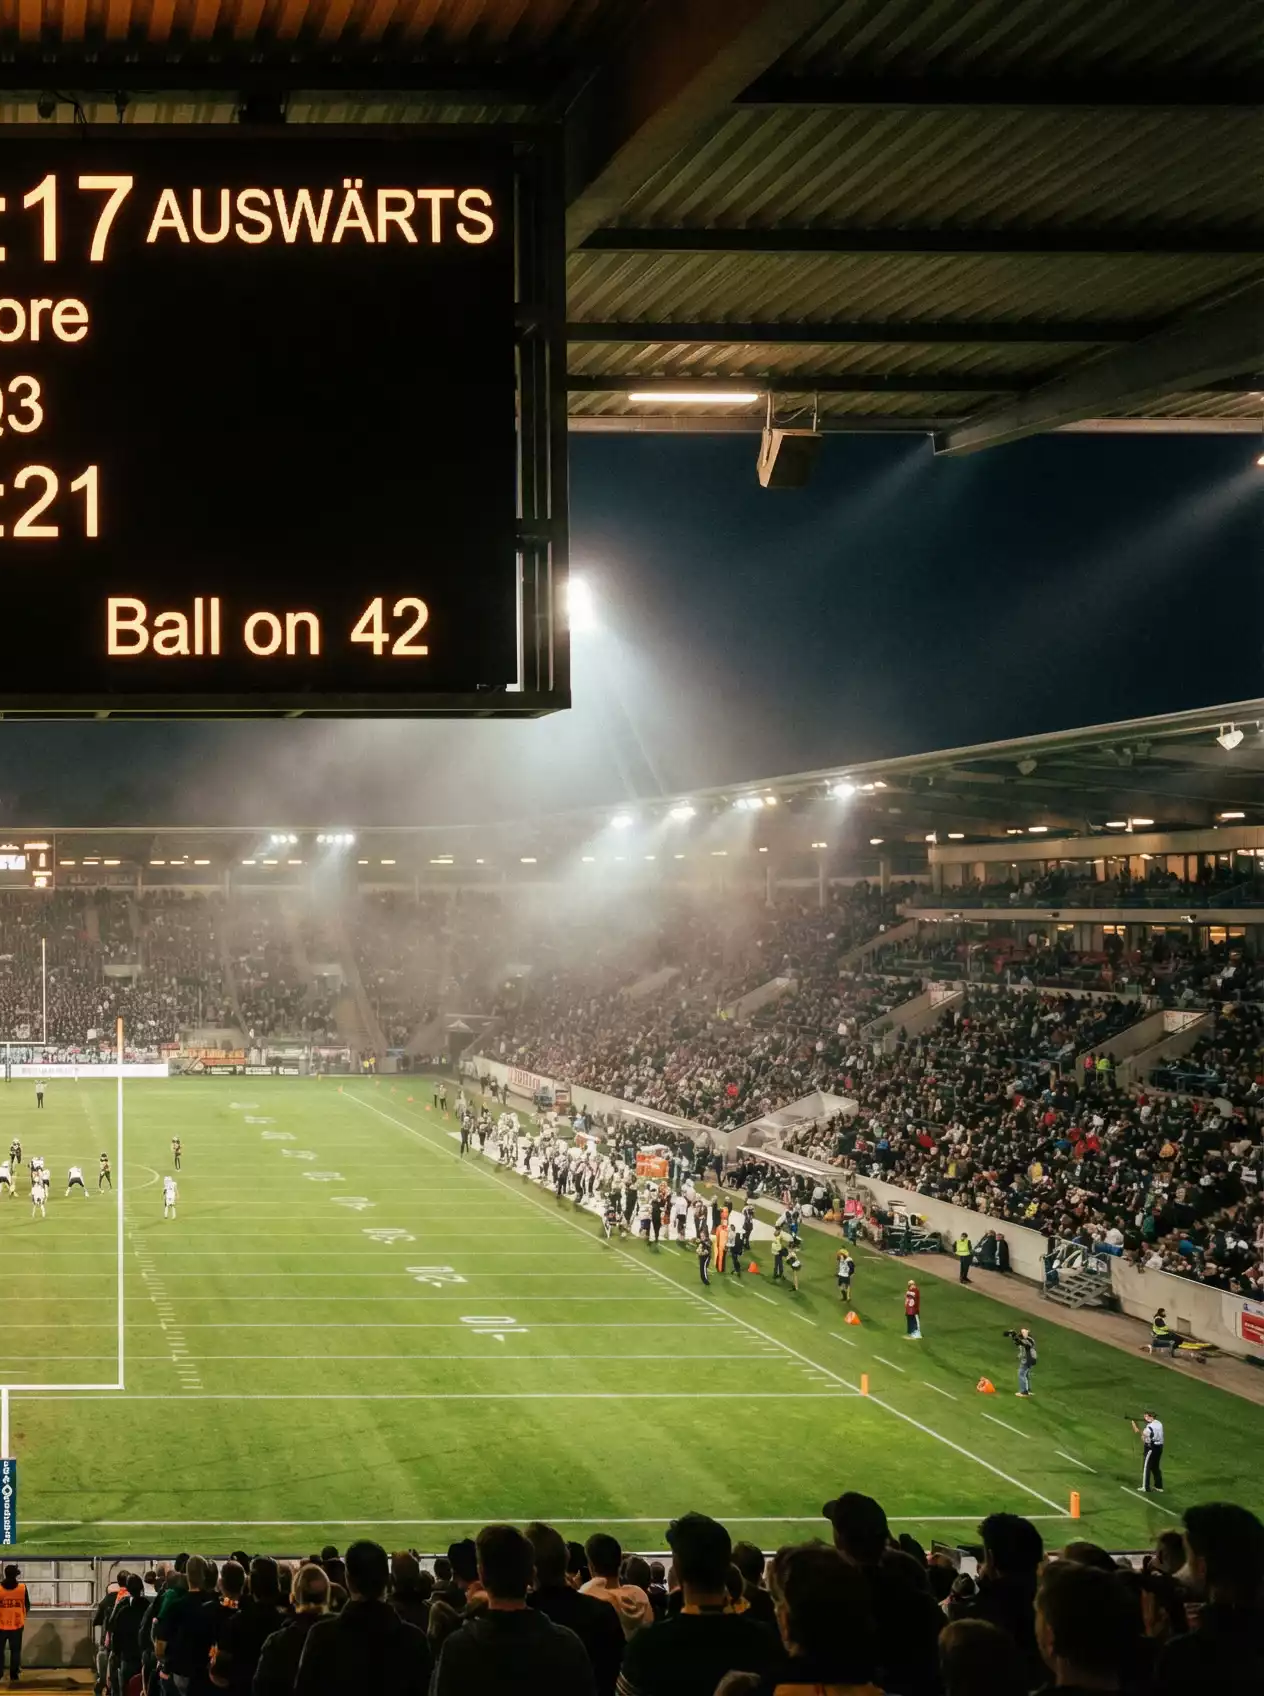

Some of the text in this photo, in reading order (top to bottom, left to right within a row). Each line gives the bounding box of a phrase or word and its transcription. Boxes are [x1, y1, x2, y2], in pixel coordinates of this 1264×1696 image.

[146, 178, 494, 245] AUSWÄRTS
[107, 597, 429, 656] Ball on 42
[405, 1266, 468, 1283] 20
[459, 1316, 529, 1333] 10
